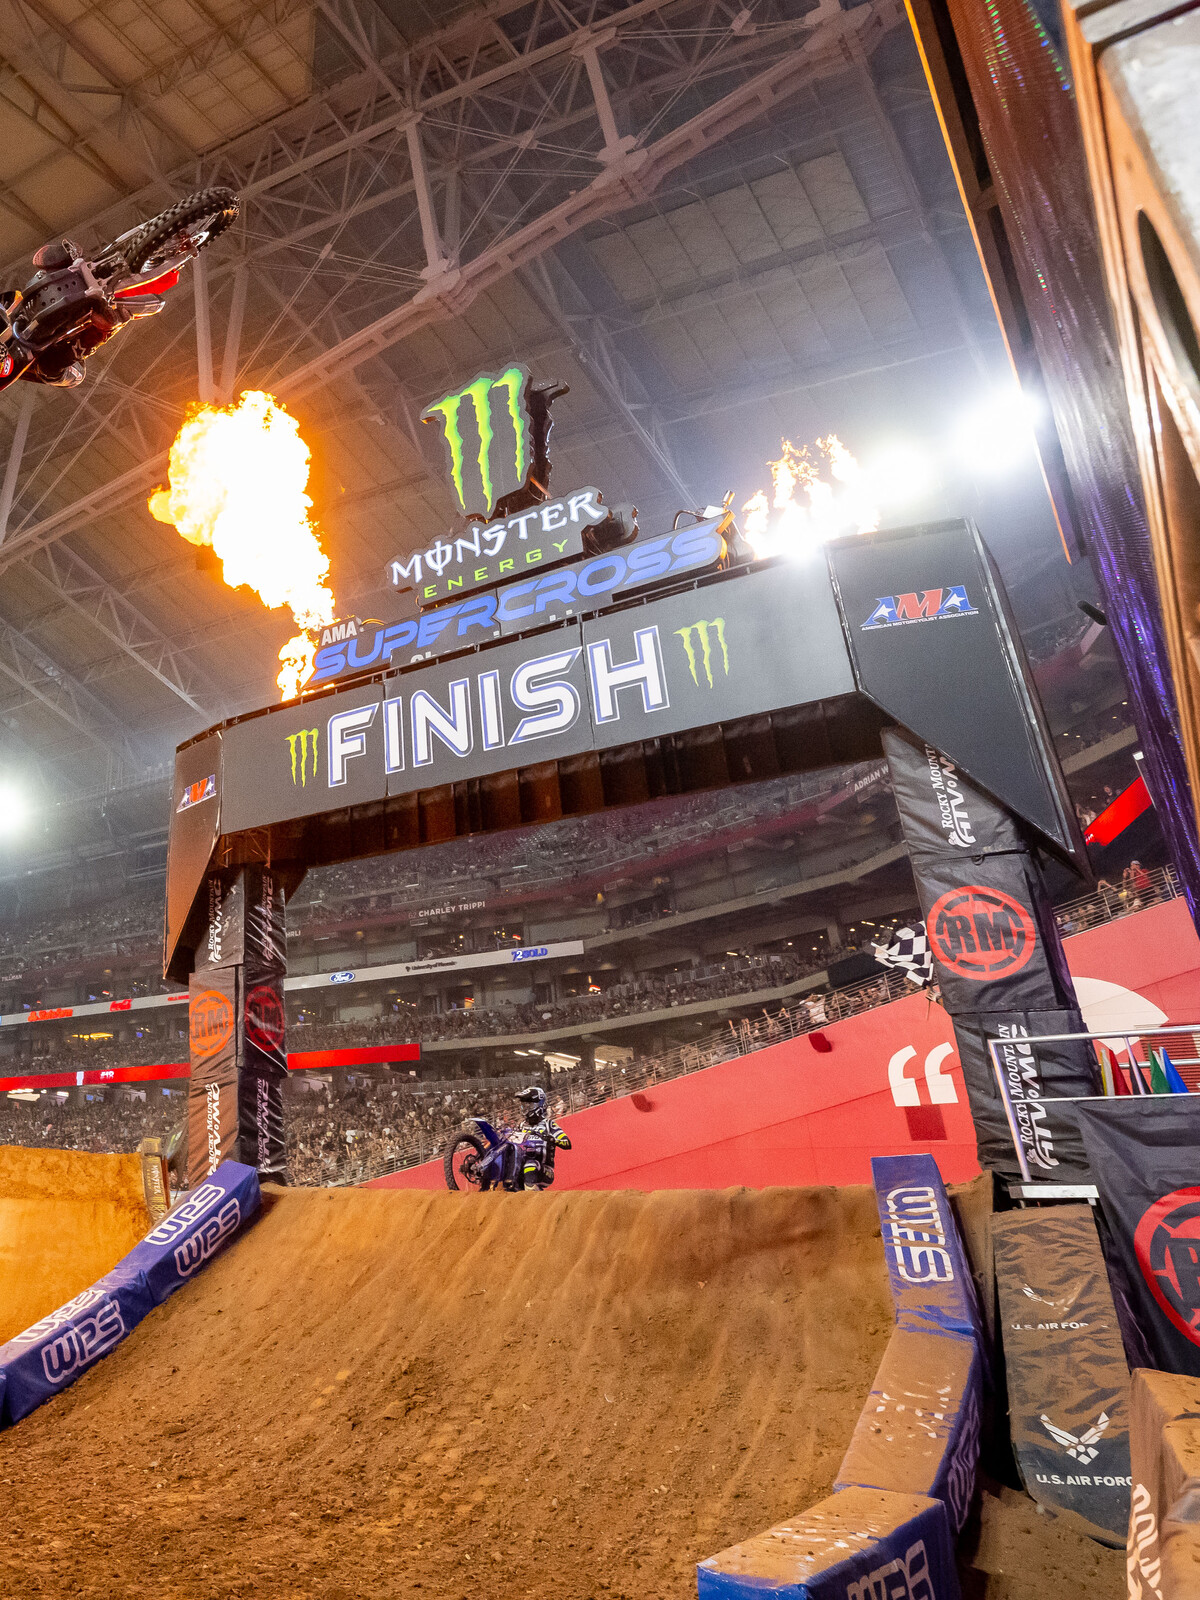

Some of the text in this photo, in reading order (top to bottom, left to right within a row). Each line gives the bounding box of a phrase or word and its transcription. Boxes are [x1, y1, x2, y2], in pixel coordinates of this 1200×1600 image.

[391, 490, 604, 585] MONSTER
[424, 539, 569, 599] ENERGY
[312, 523, 720, 680] SUPERCROSS
[860, 585, 978, 627] AMA
[321, 622, 357, 647] AMA
[327, 625, 671, 788] FINISH
[176, 774, 217, 810] AMA
[854, 771, 881, 792] ADRIAN
[925, 744, 954, 829] ROCKY MOUNT
[419, 905, 456, 917] CHARLEY
[458, 901, 486, 912] TRIPPI
[949, 908, 1017, 954] RM
[193, 1007, 225, 1033] RM
[206, 1083, 214, 1132] MOUNTAIN
[1016, 1103, 1034, 1145] ROCKY
[144, 1184, 226, 1245] WPS
[174, 1198, 241, 1277] WPS
[42, 1299, 126, 1383] WPS
[1037, 1322, 1059, 1330] AIR
[1035, 1474, 1133, 1486] U.S. AIR FORC
